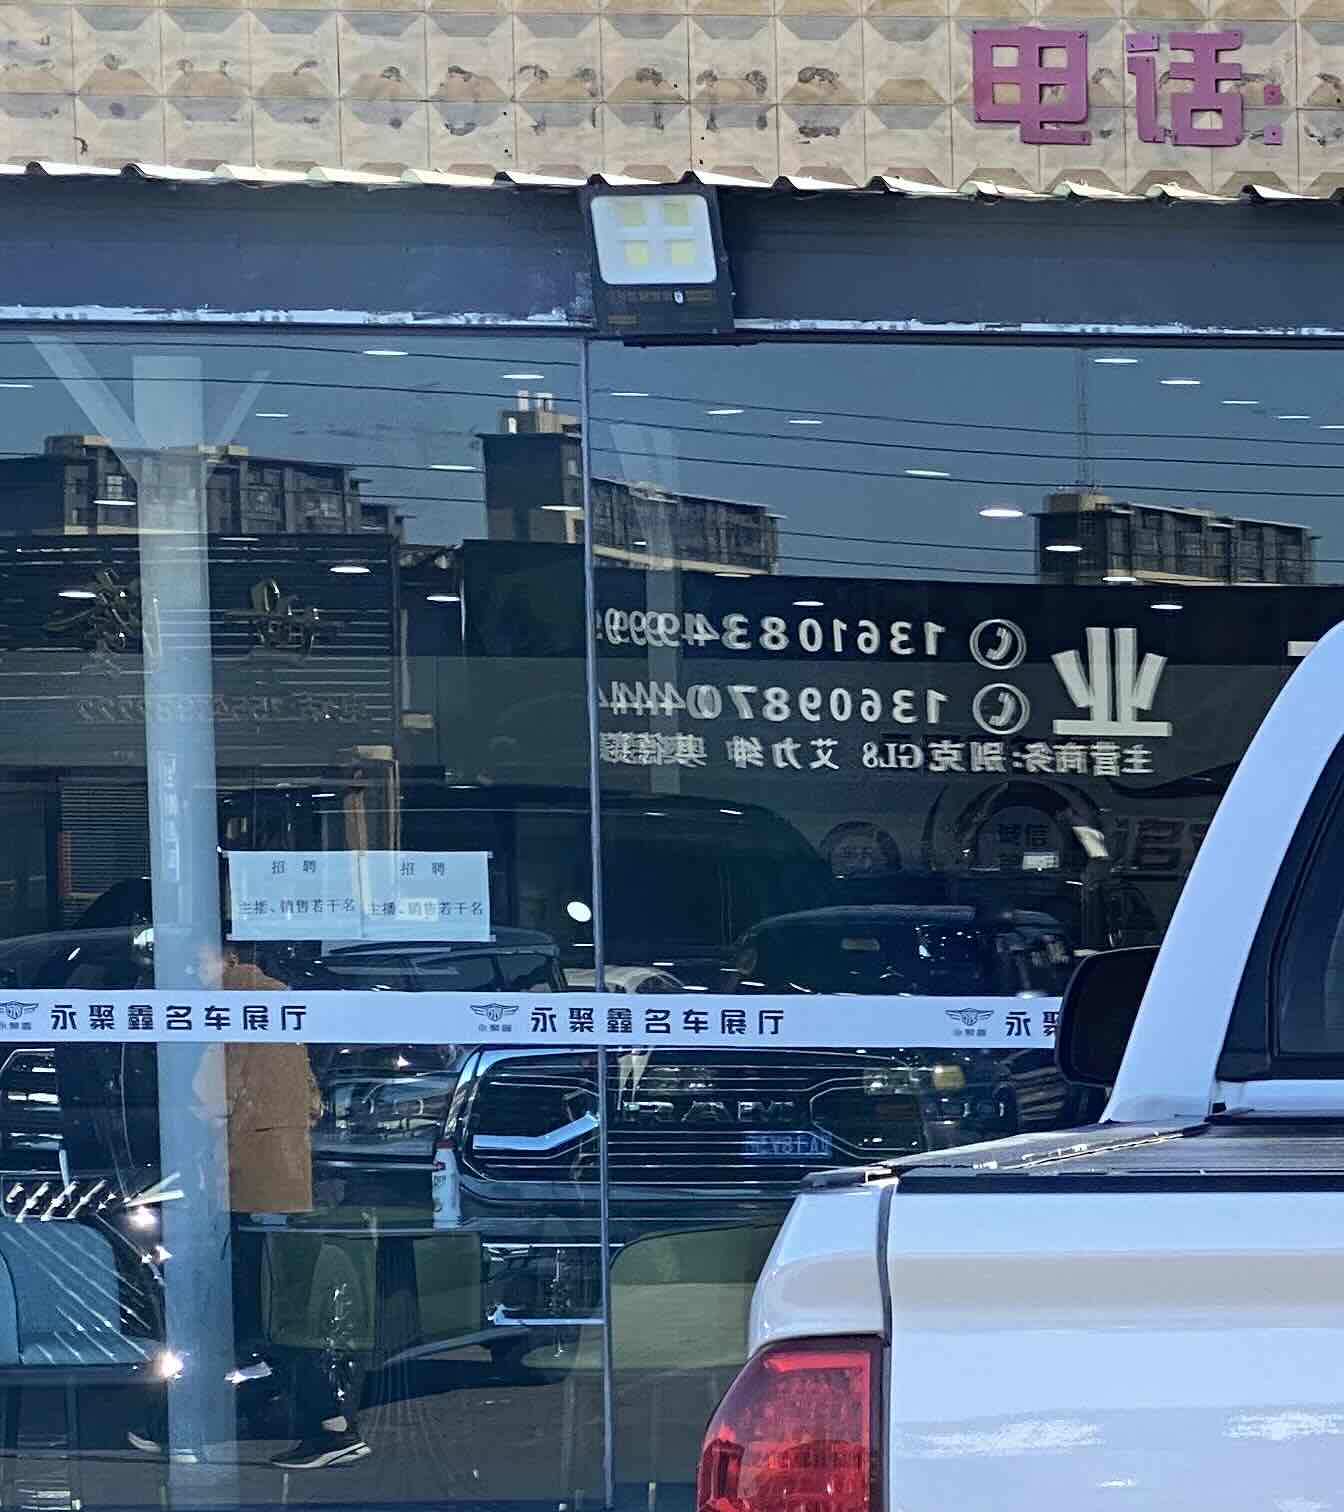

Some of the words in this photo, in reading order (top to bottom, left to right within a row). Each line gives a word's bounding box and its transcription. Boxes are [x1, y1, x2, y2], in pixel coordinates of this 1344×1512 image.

[972, 26, 1282, 147] 电话:
[51, 1004, 307, 1031] 永聚鑫名车展厅
[531, 1007, 785, 1035] 永聚鑫名车展厅
